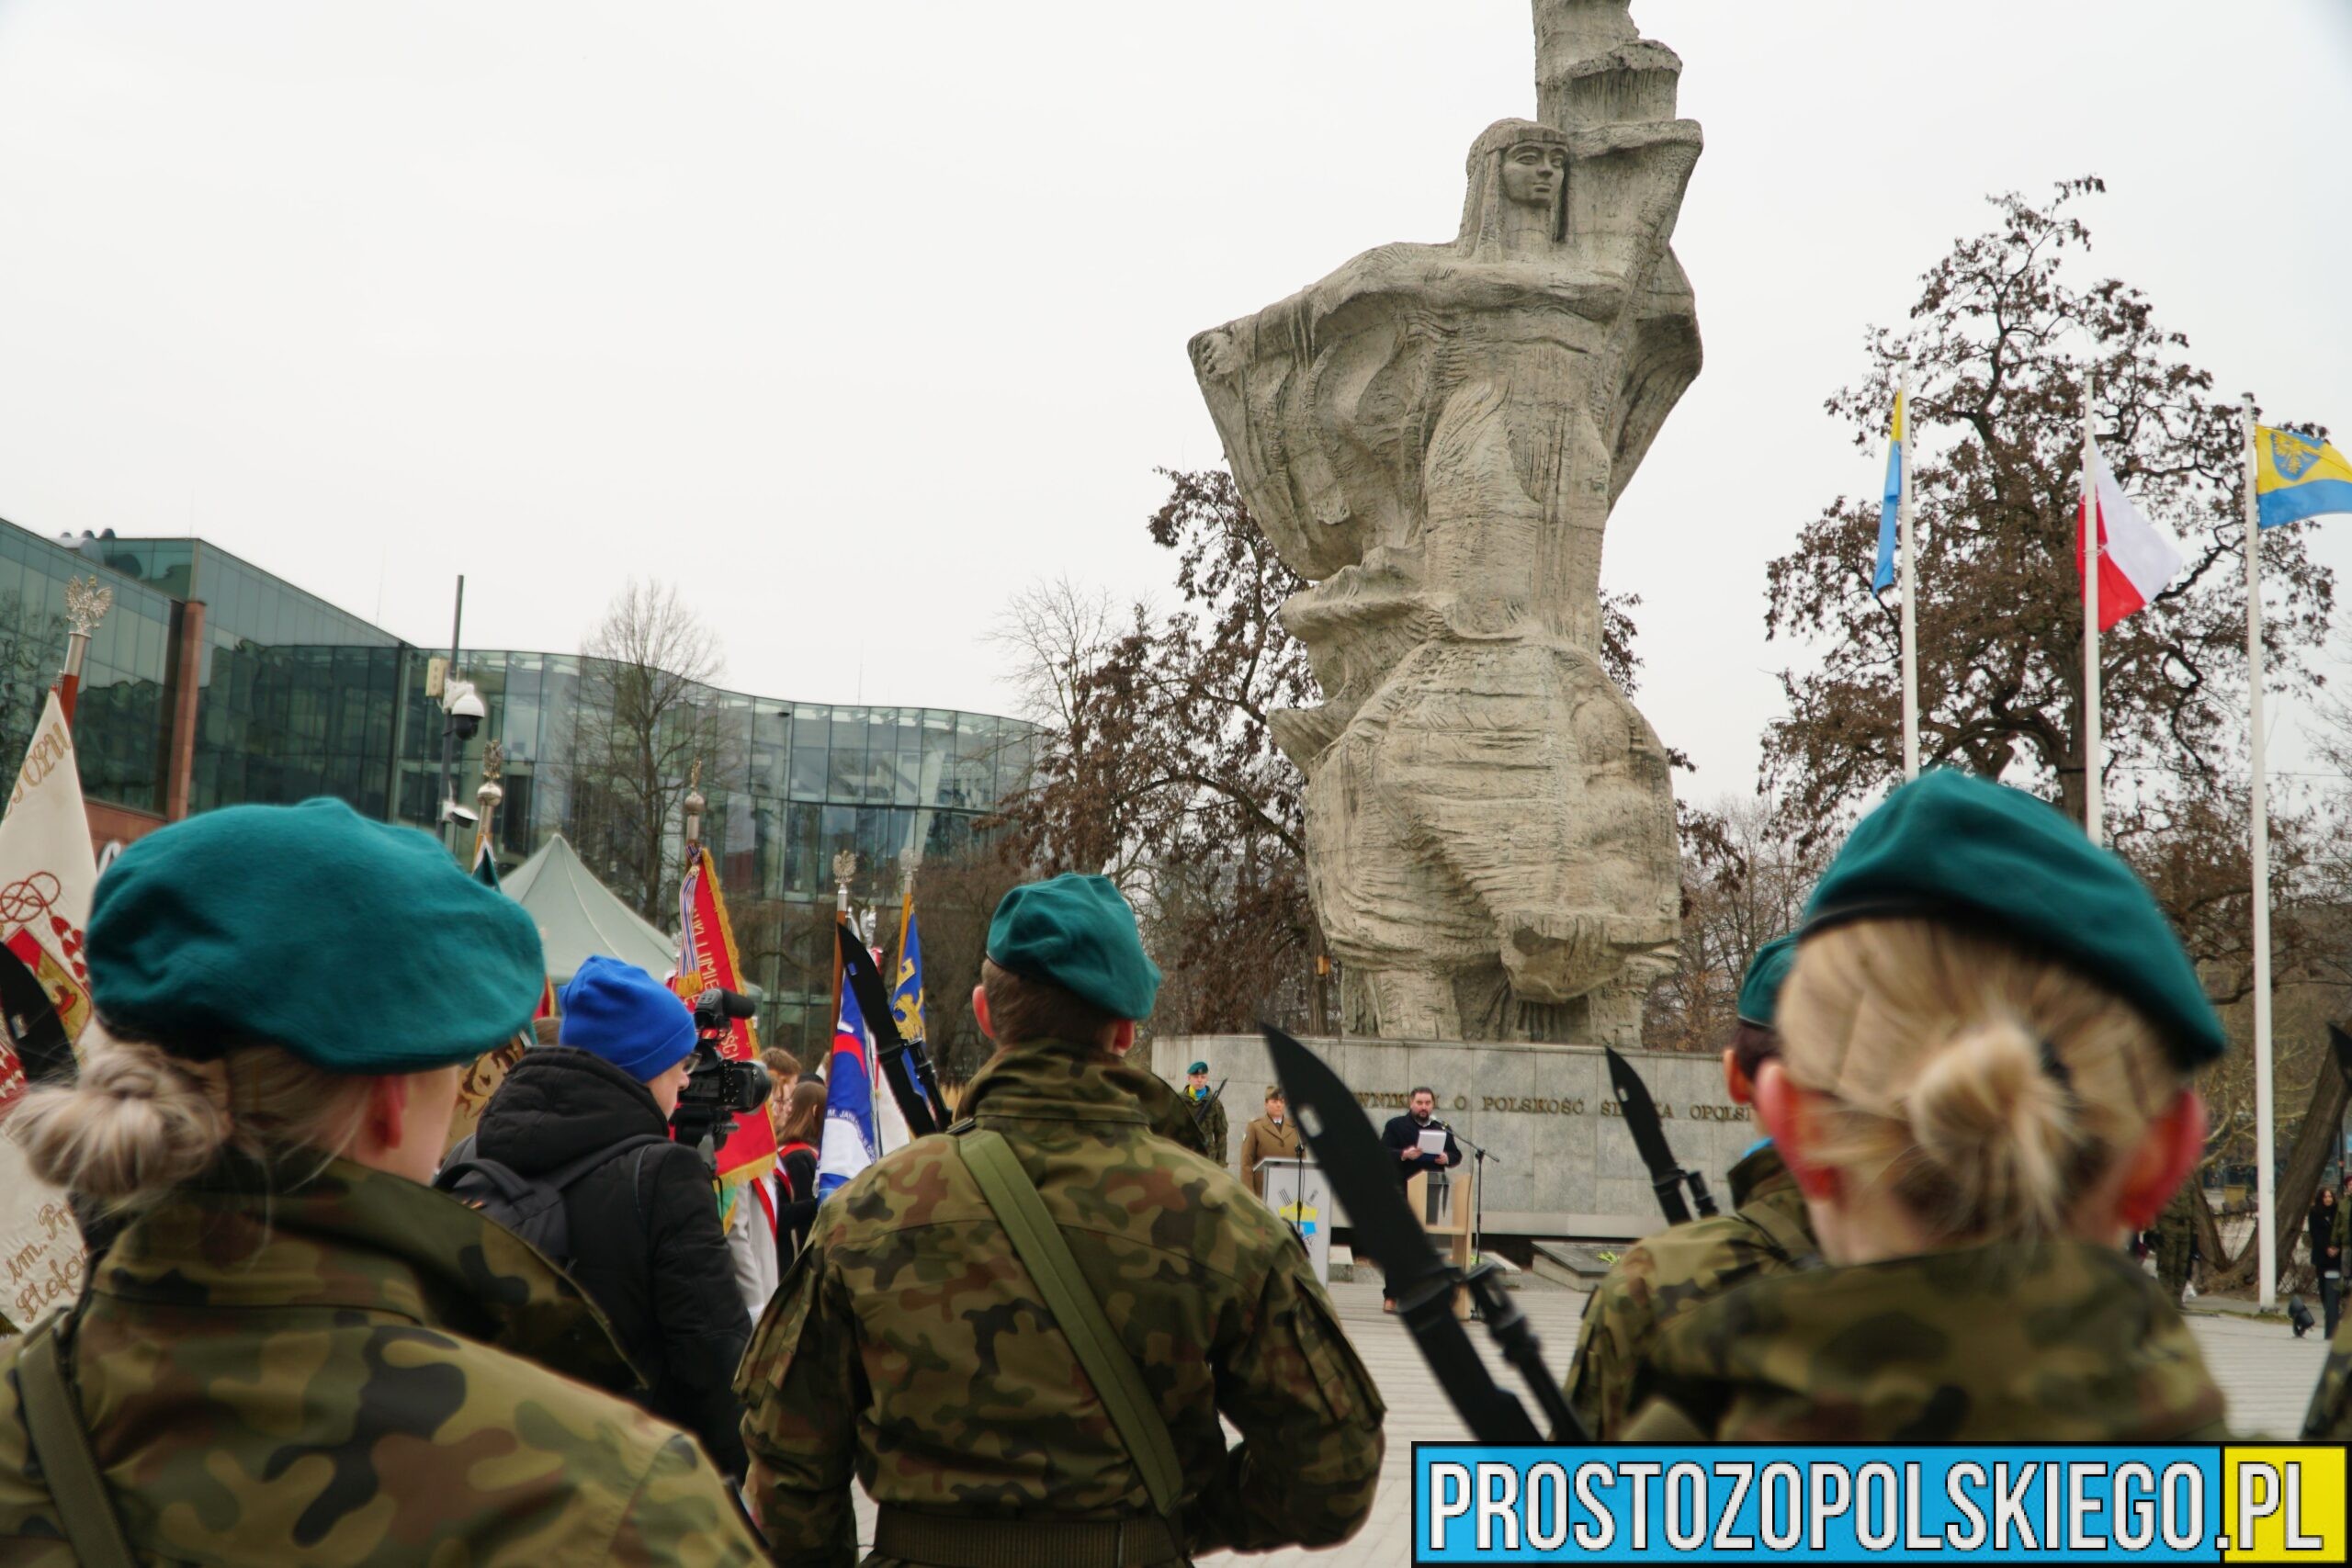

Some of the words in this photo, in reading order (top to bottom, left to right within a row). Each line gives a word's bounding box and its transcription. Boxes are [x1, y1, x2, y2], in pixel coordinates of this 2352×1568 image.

[1453, 1096, 1467, 1111] O
[1482, 1096, 1585, 1114] POLSKOŚĆ
[1600, 1099, 1675, 1119] ŚLA
[1690, 1104, 1750, 1122] OPOLS
[6, 1243, 48, 1286] im.
